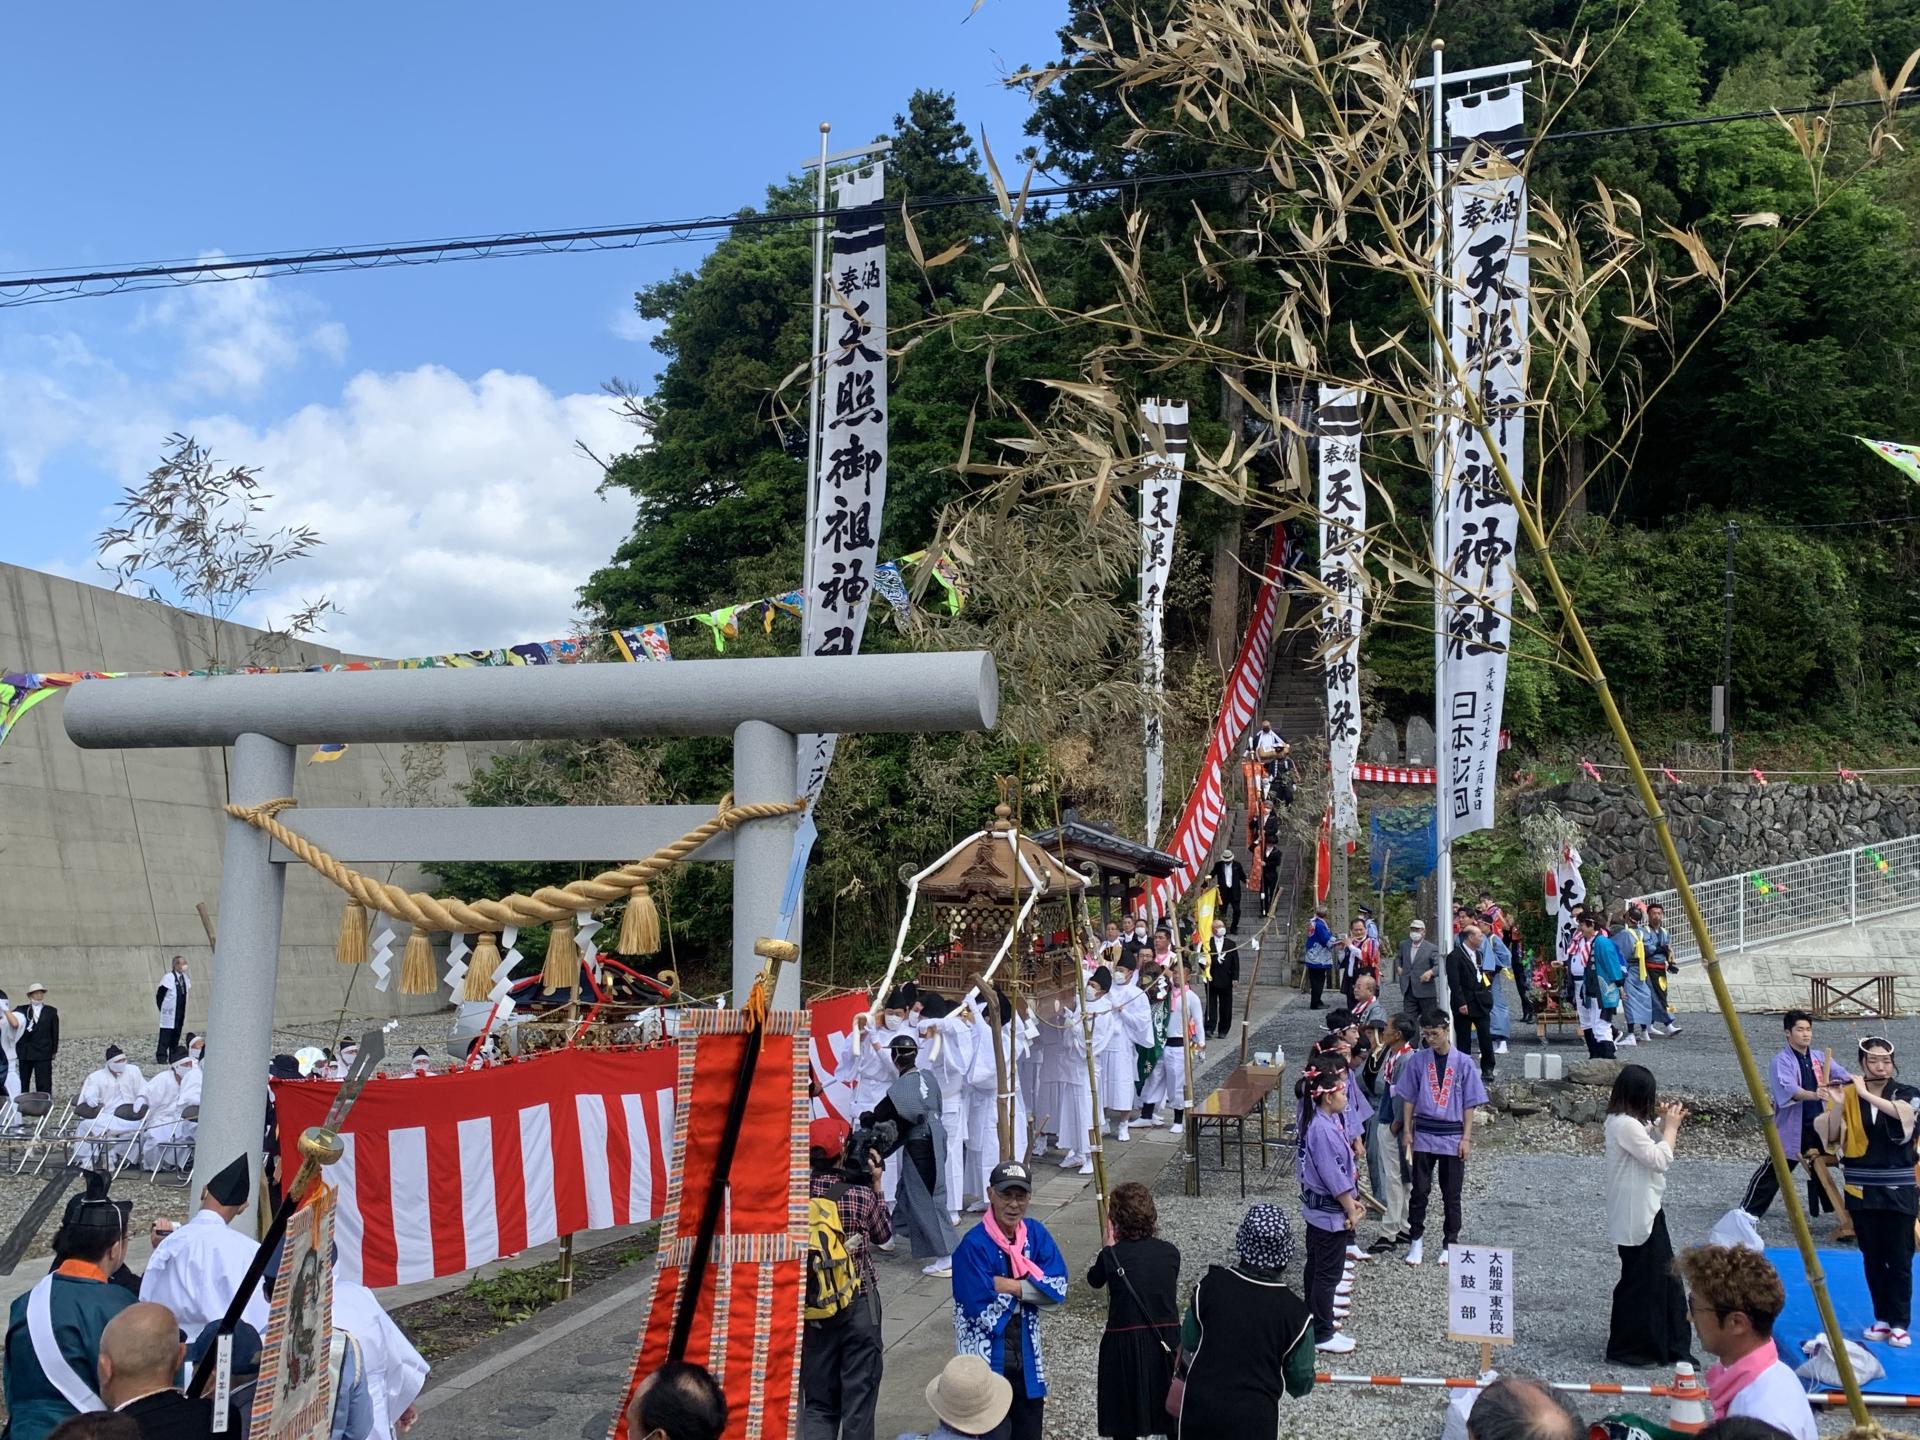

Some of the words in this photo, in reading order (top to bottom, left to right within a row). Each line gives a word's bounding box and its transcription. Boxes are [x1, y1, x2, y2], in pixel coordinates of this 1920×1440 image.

[1459, 190, 1519, 231] 奉納
[838, 262, 880, 297] 奉納
[1460, 1250, 1477, 1320] 太鼓部
